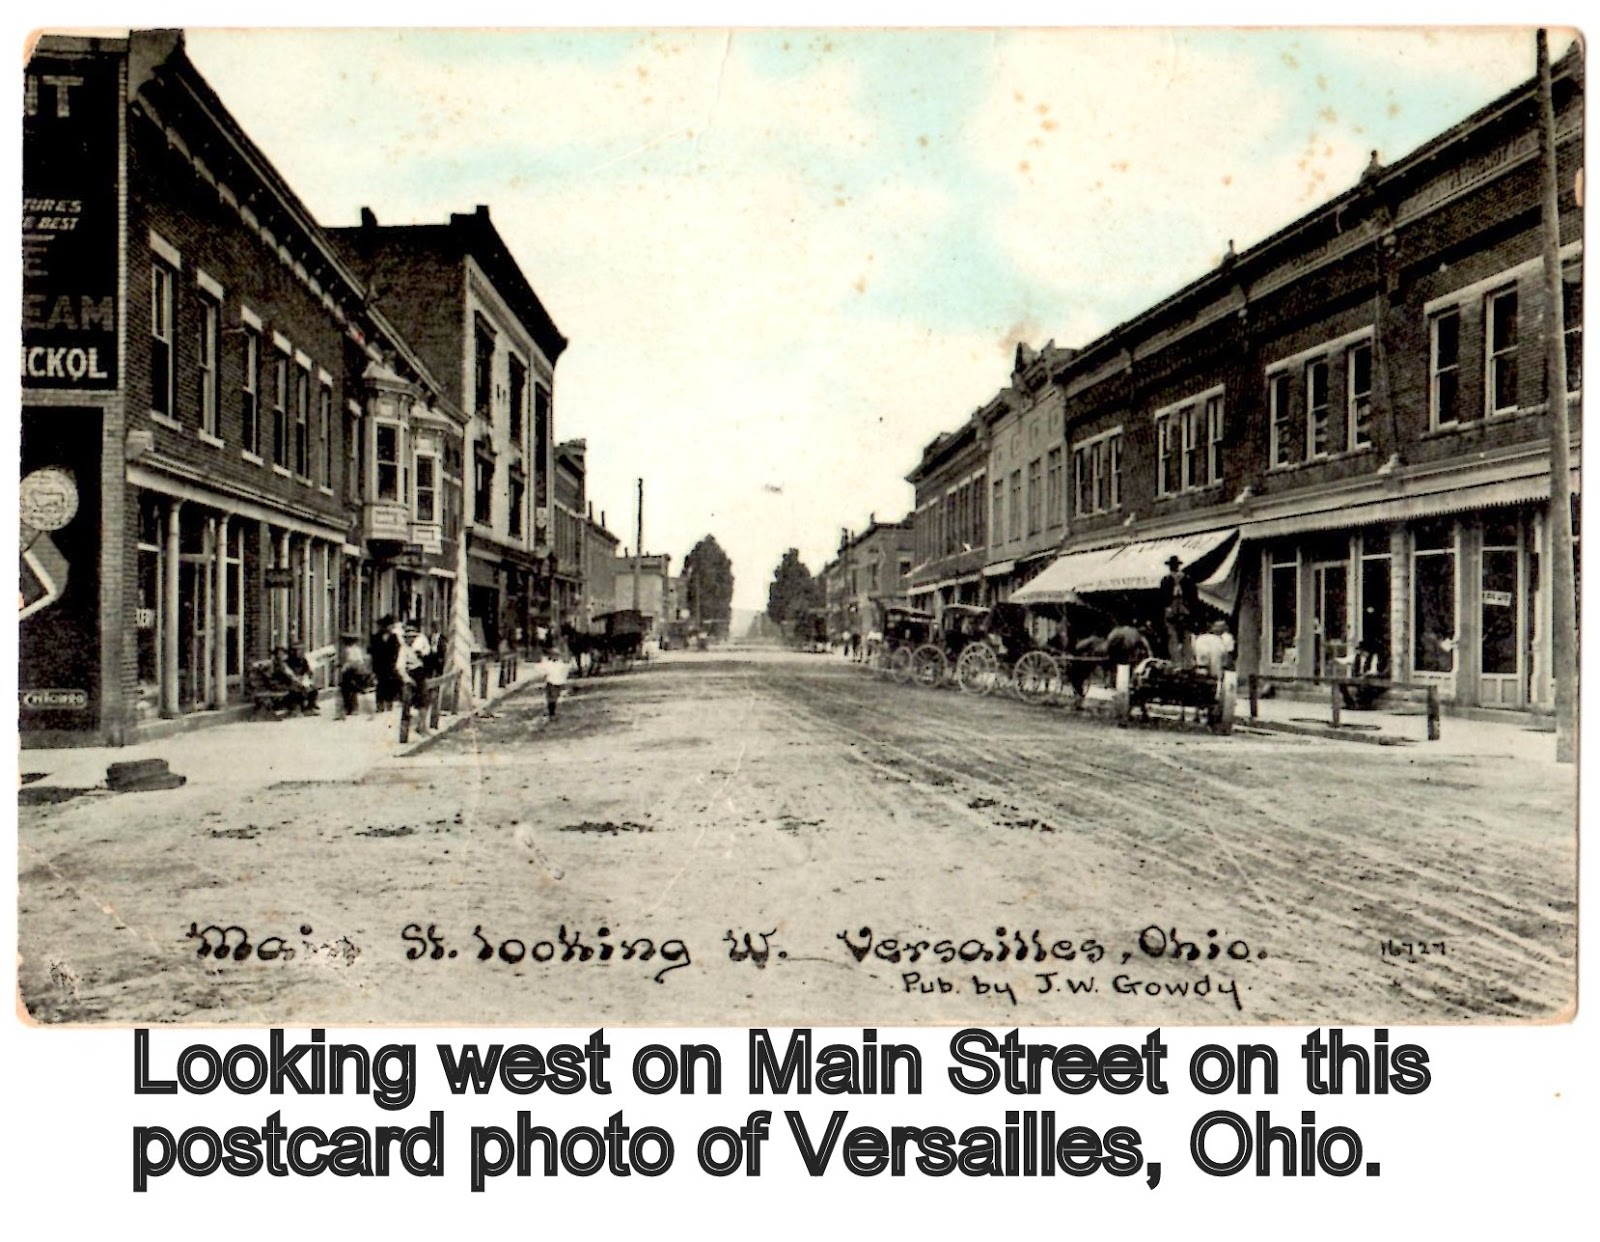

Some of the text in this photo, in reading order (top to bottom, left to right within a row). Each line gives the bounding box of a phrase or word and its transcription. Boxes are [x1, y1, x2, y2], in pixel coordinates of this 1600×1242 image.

[37, 216, 79, 230] BEST
[902, 972, 960, 994] Pub.
[972, 975, 1018, 1006] by
